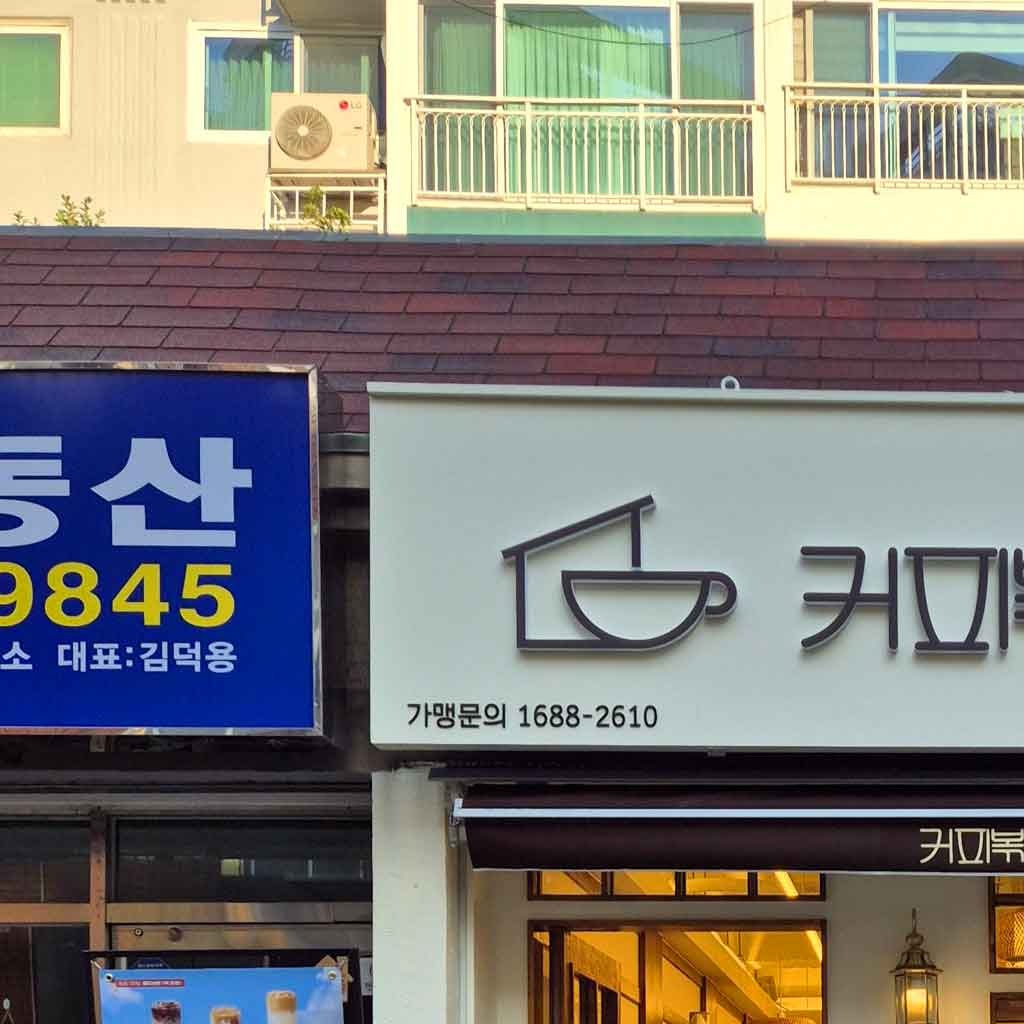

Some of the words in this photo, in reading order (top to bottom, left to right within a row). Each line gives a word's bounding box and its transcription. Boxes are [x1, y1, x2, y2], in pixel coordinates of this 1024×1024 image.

[57, 640, 238, 674] 대표:김덕용
[406, 703, 508, 729] 가맹문의
[518, 704, 659, 729] 1688-2610
